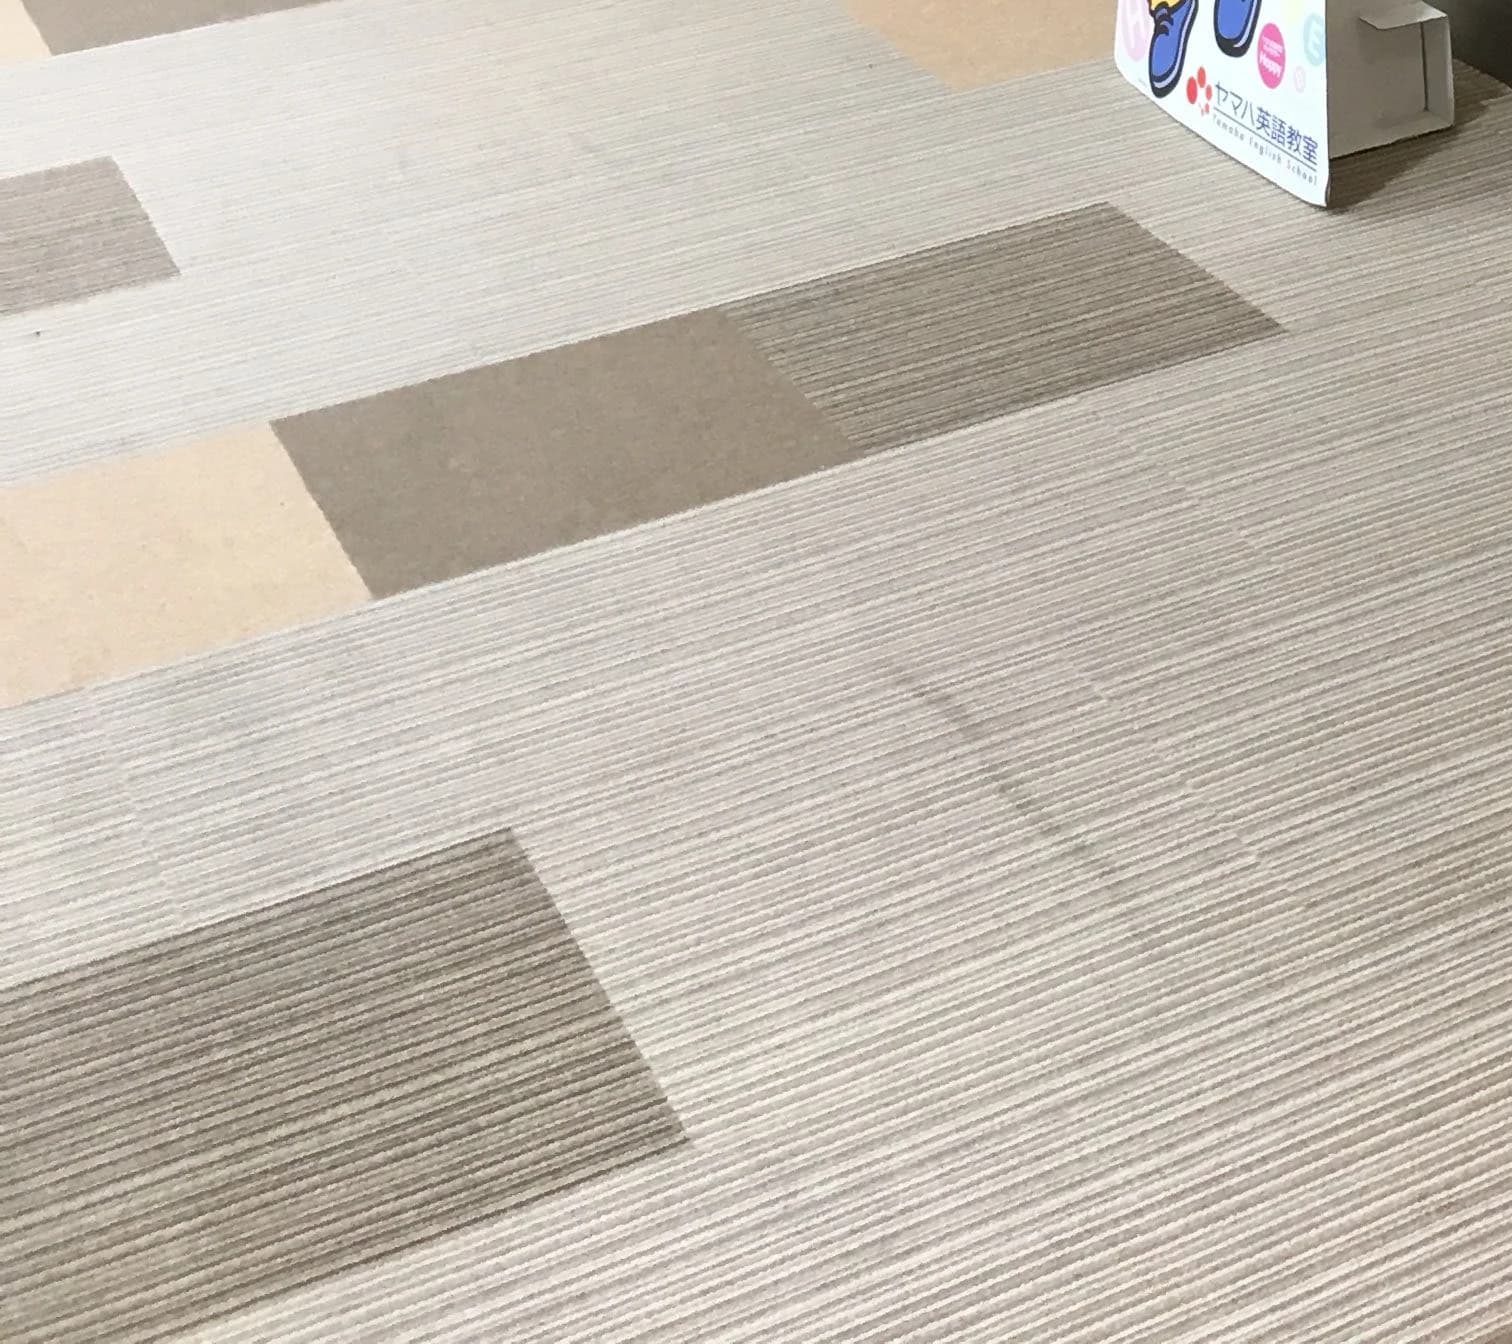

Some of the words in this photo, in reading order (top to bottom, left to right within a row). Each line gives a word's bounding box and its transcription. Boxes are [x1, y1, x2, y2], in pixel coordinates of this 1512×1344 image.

[1215, 81, 1319, 166] ヤマハ英語教室
